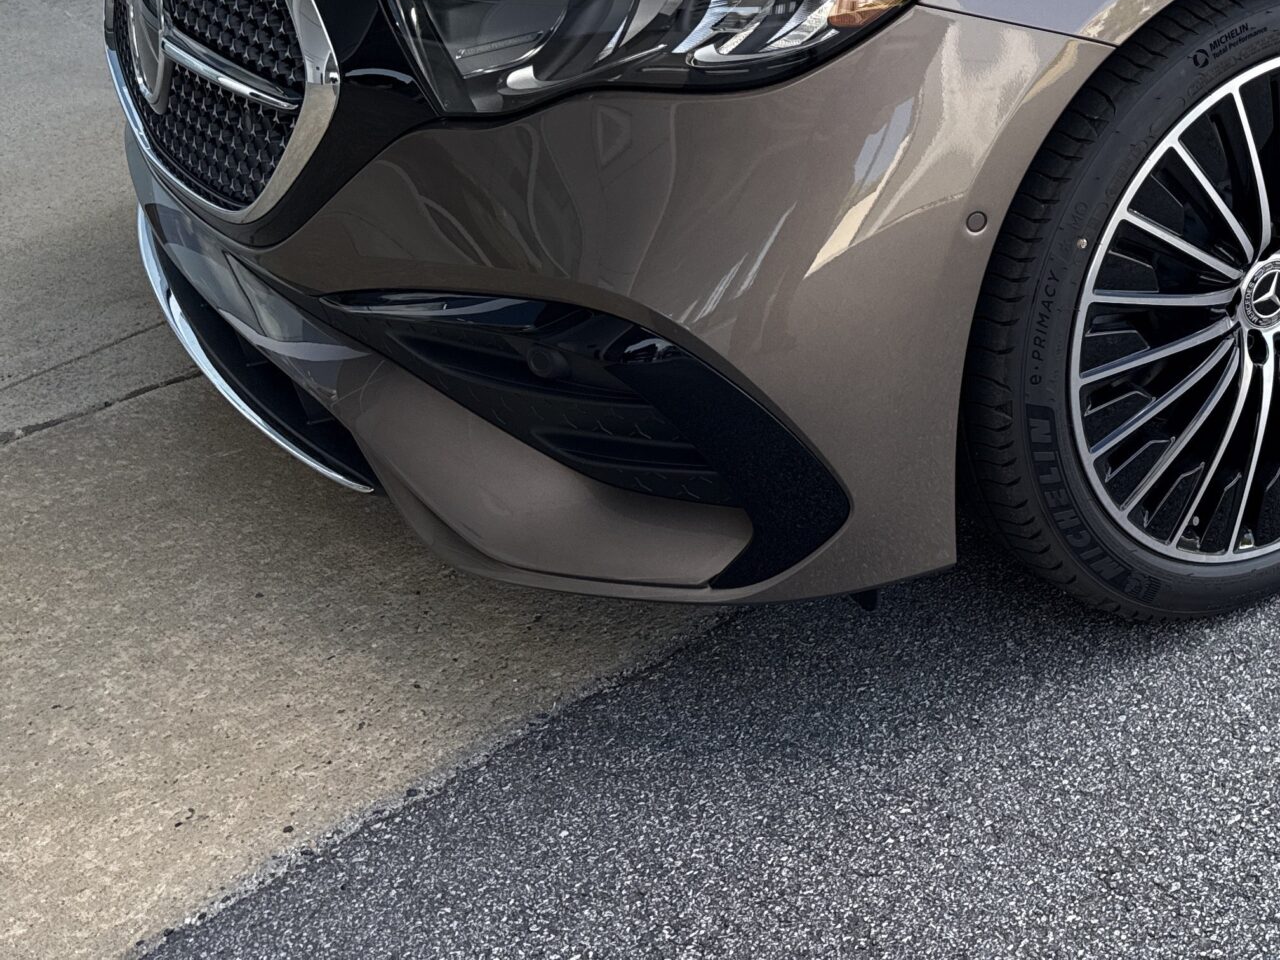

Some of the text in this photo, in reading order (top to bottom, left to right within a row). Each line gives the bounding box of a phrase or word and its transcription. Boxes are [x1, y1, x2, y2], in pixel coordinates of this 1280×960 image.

[1209, 23, 1249, 51] MICHELIN
[1212, 46, 1228, 59] Total
[1228, 26, 1268, 50] Performance
[1244, 281, 1259, 324] MERCEDES
[1028, 417, 1125, 581] MICHELIN
